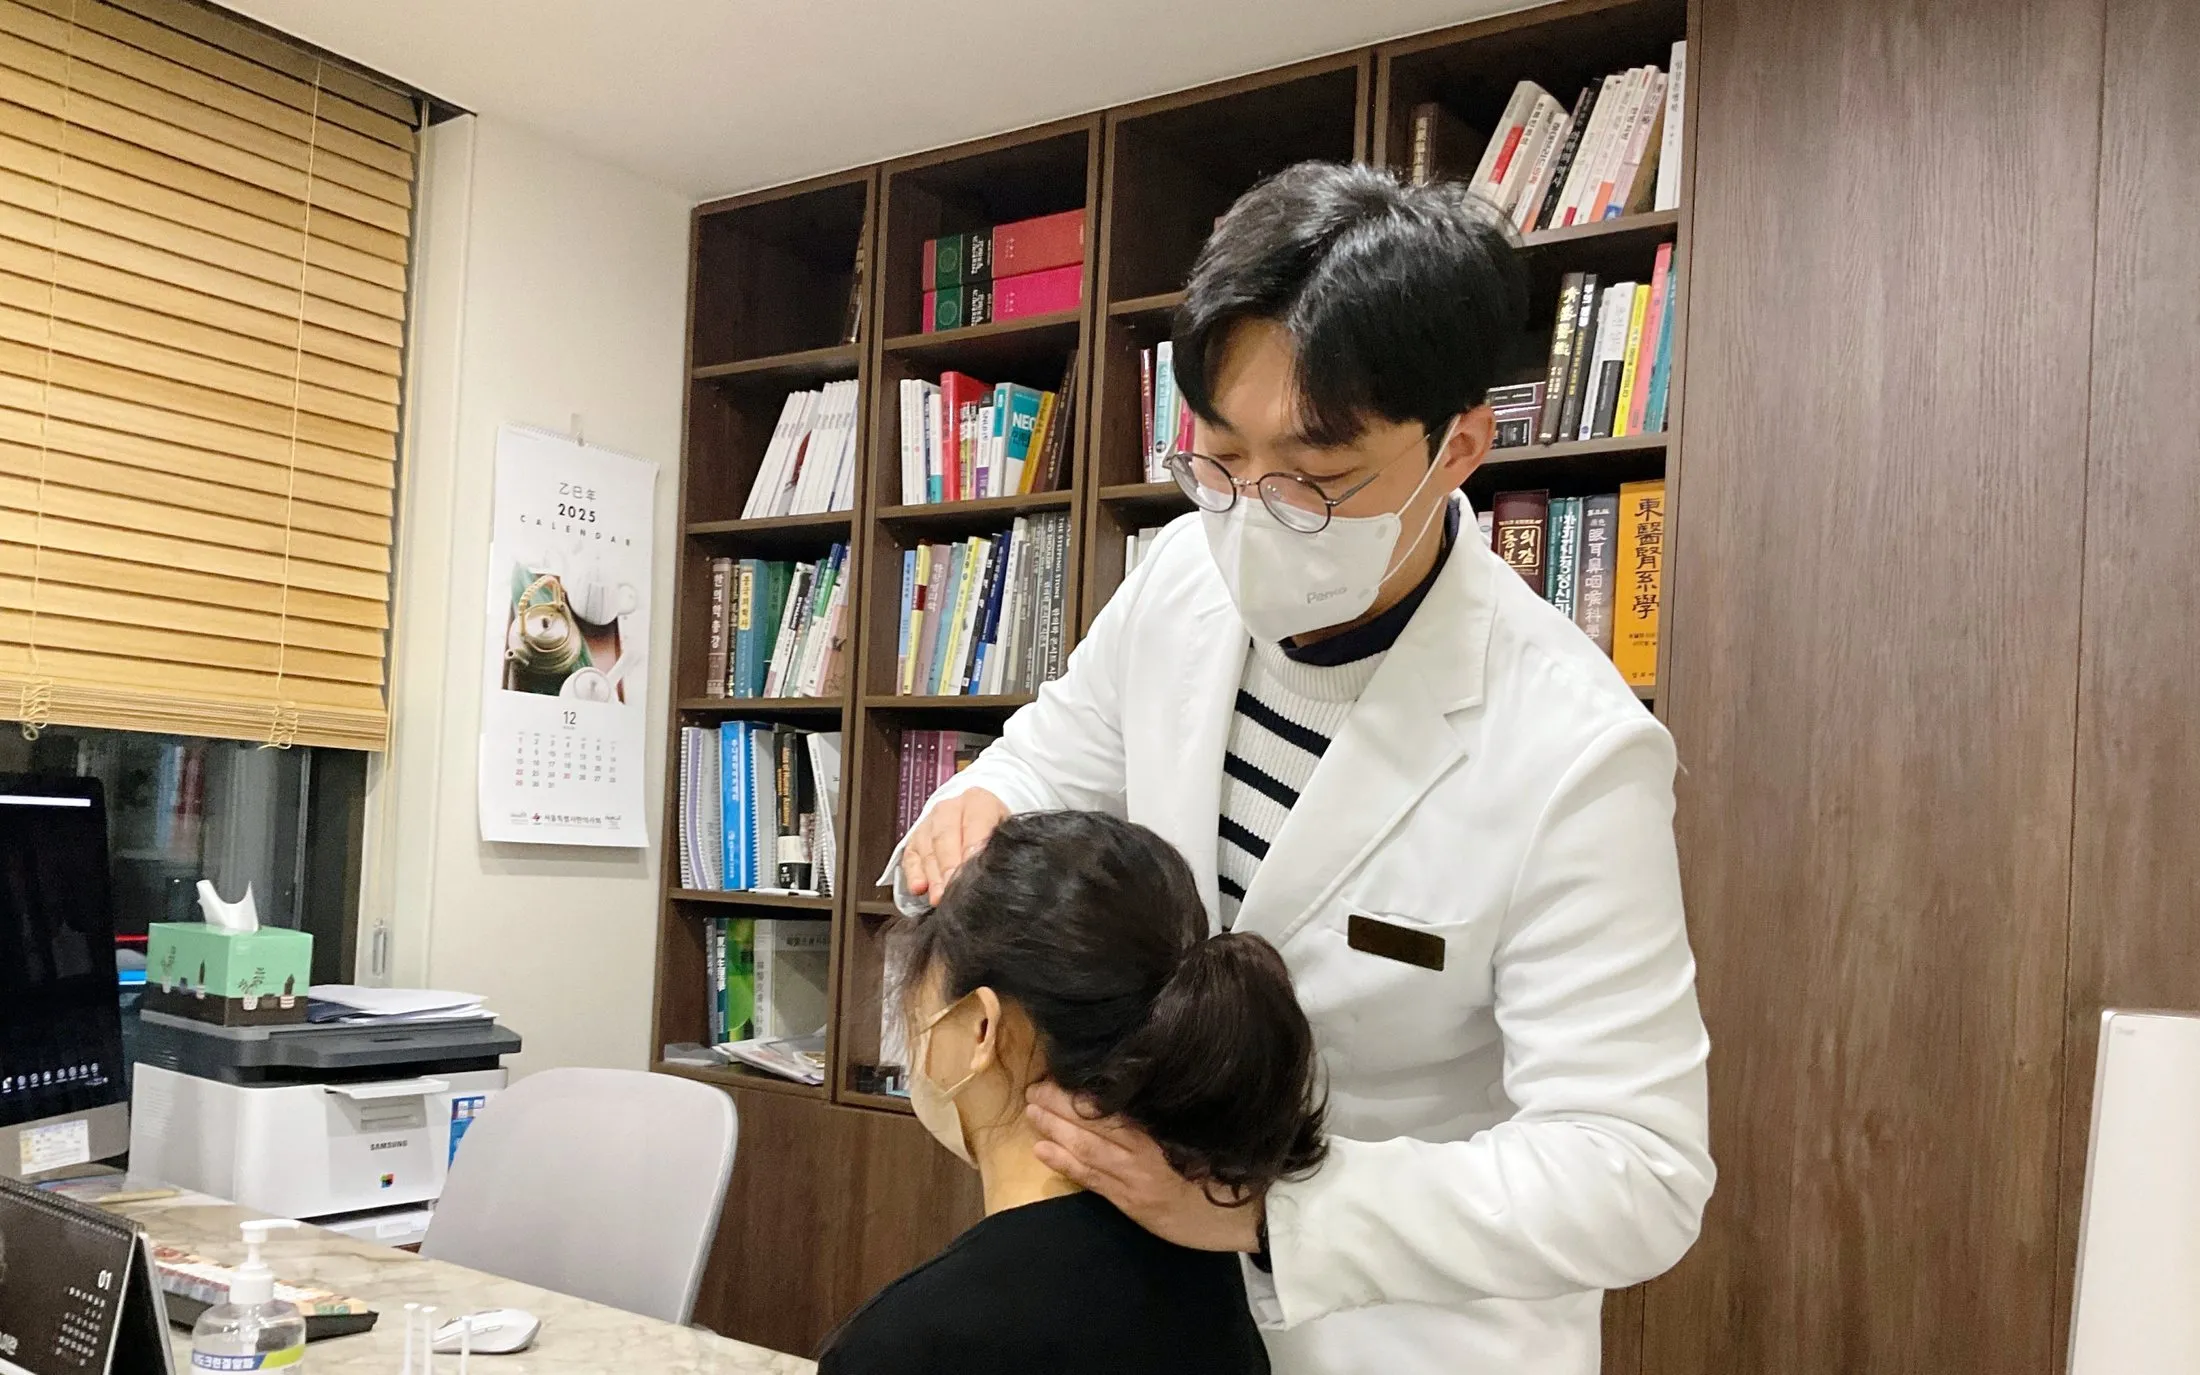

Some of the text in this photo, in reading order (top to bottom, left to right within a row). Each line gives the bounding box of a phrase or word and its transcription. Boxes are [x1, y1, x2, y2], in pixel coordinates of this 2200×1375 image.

[559, 482, 596, 501] 乙巳年
[558, 503, 596, 522] 2025
[520, 514, 630, 546] CALENDAR
[1501, 529, 1536, 549] 동의
[563, 711, 577, 725] 12
[370, 1140, 408, 1151] SAMSUNG
[98, 1269, 112, 1290] 01
